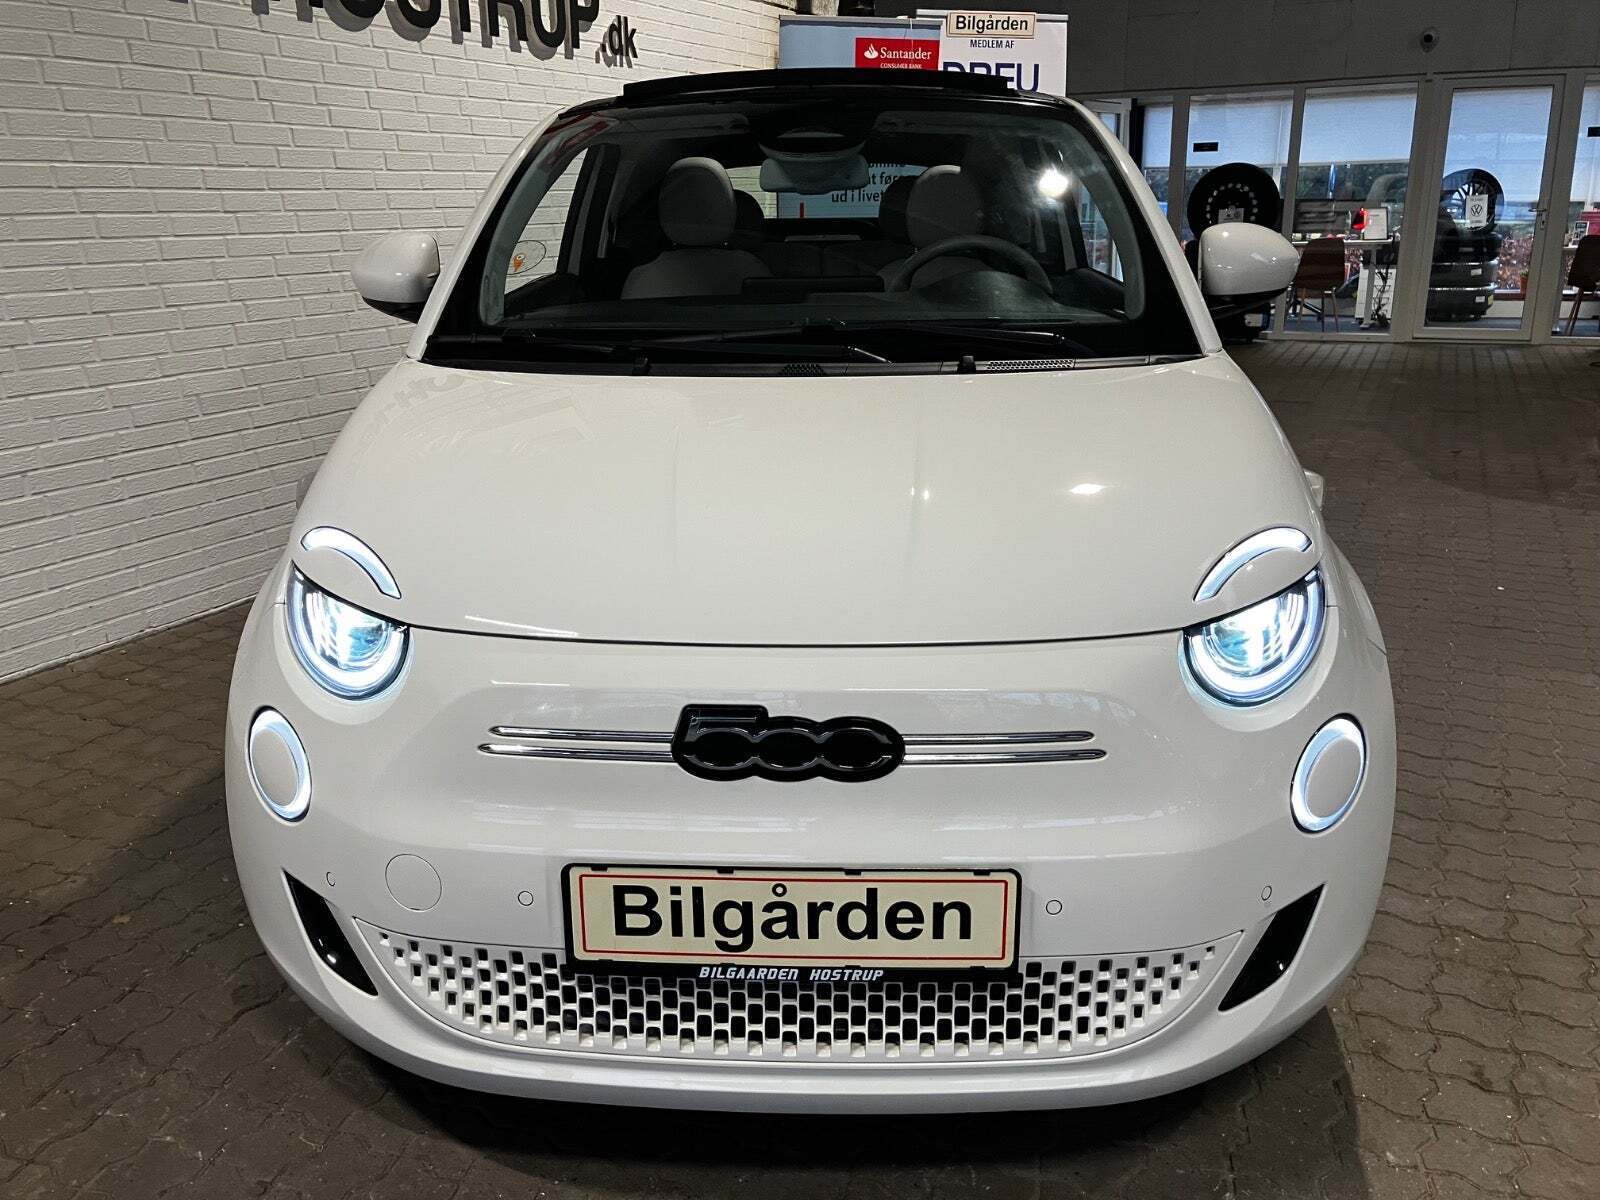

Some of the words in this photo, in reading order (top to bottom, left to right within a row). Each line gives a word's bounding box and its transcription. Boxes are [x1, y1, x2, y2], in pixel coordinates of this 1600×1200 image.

[955, 15, 1028, 34] Bilgården
[970, 40, 1002, 48] MEDLEM
[1005, 40, 1015, 49] AF
[880, 47, 932, 60] Santander
[831, 188, 847, 202] ud
[671, 703, 905, 783] 500
[612, 884, 972, 953] Bilgården
[699, 966, 799, 981] BILGAARDEN
[809, 968, 884, 981] HOSTRUP
